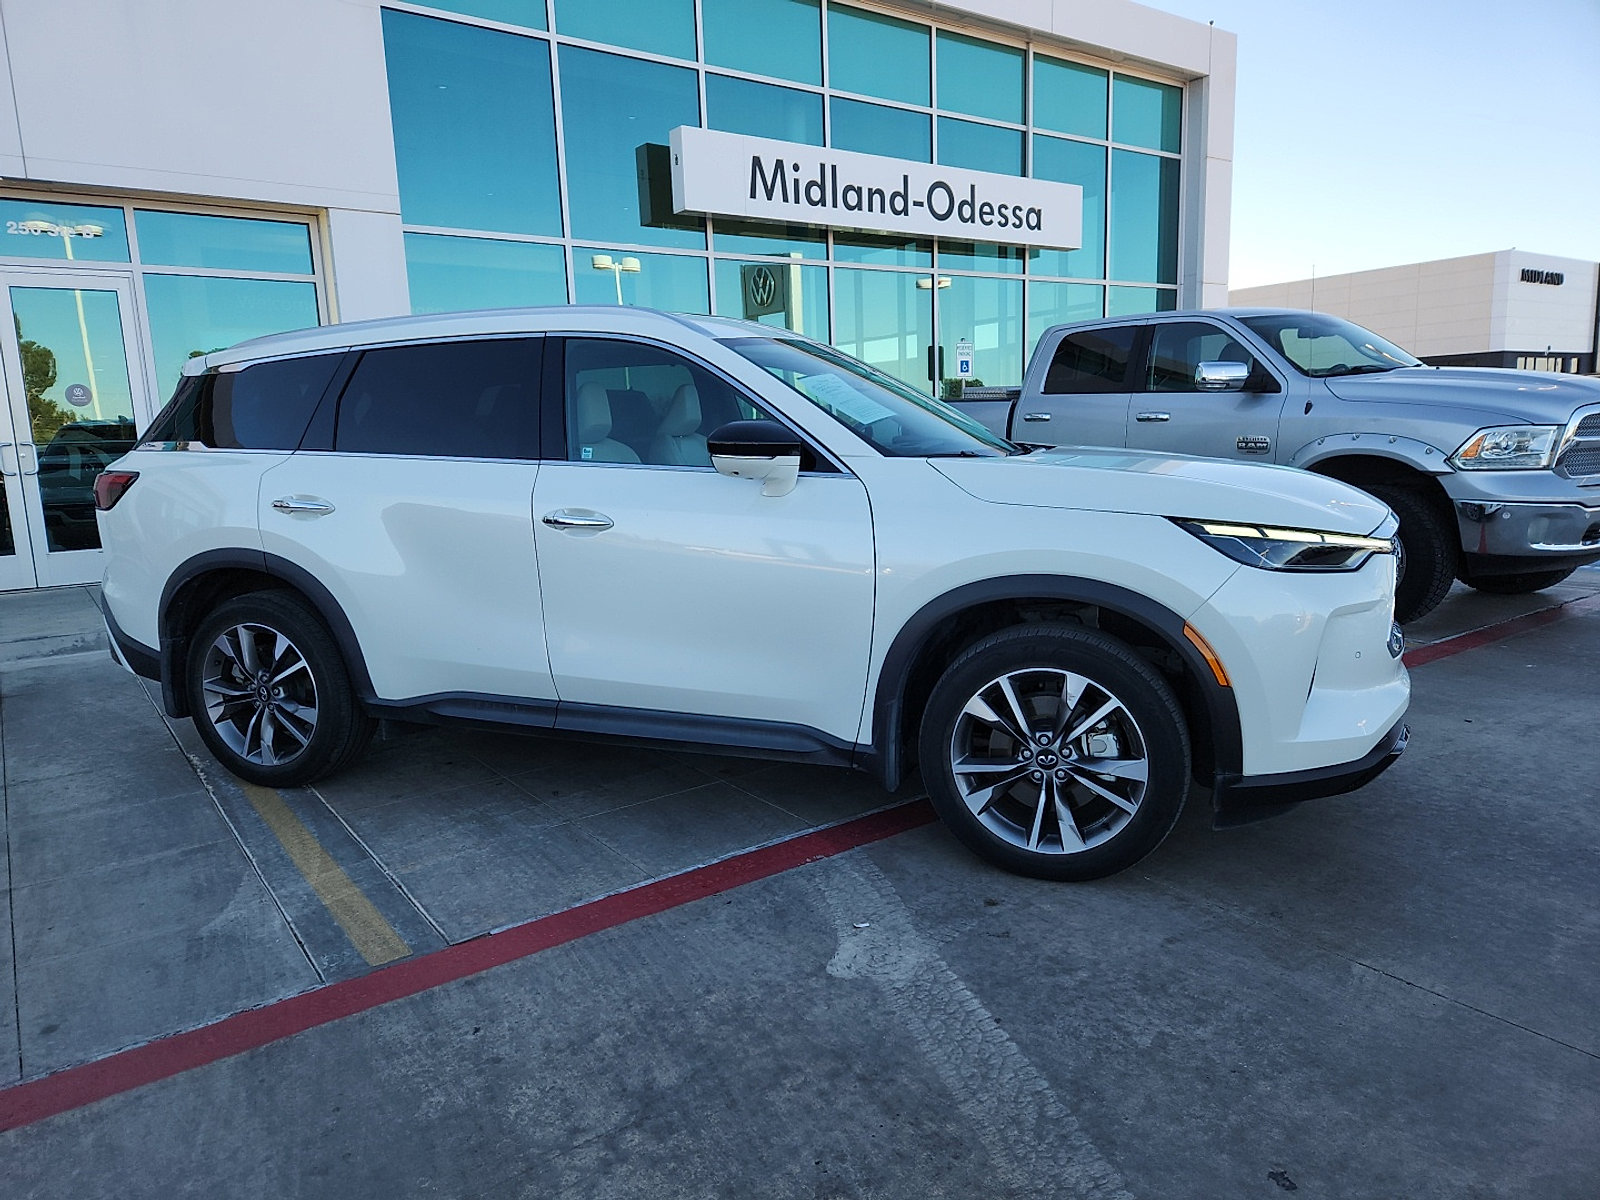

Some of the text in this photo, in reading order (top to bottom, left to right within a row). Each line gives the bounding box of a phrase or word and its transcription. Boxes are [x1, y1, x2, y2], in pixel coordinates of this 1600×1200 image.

[749, 155, 1043, 231] Midland-Odessa
[6, 220, 41, 236] 250
[1520, 268, 1563, 285] MIDLAND
